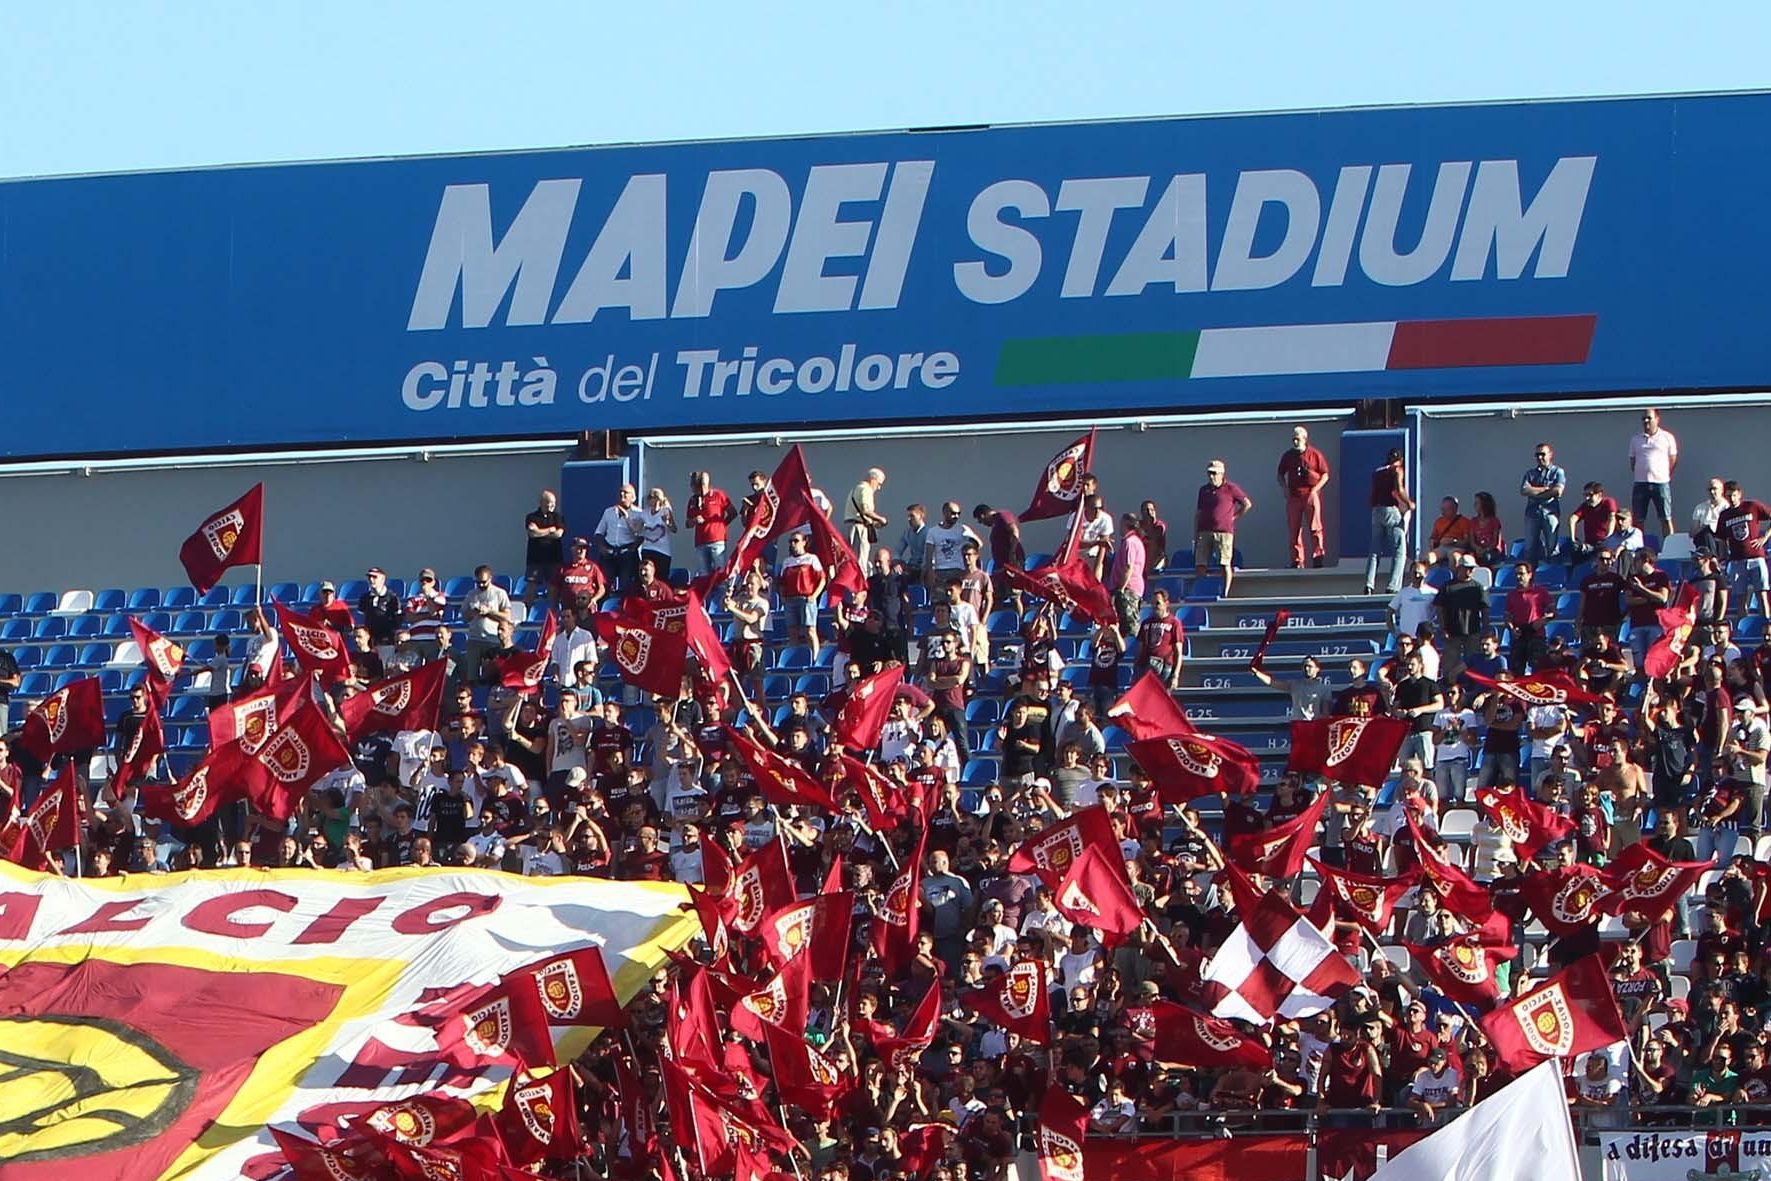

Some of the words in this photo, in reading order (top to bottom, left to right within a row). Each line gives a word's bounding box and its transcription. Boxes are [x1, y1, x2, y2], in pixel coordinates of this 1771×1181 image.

[407, 159, 936, 332] MAPEI
[953, 154, 1598, 306] STADIUM
[401, 356, 557, 412] Città
[577, 352, 660, 403] del
[676, 344, 960, 400] Tricolore
[1287, 618, 1316, 628] FILA
[1348, 616, 1365, 626] 28
[1214, 679, 1231, 688] 26
[1196, 709, 1212, 719] 25
[1626, 1134, 1698, 1162] difesa
